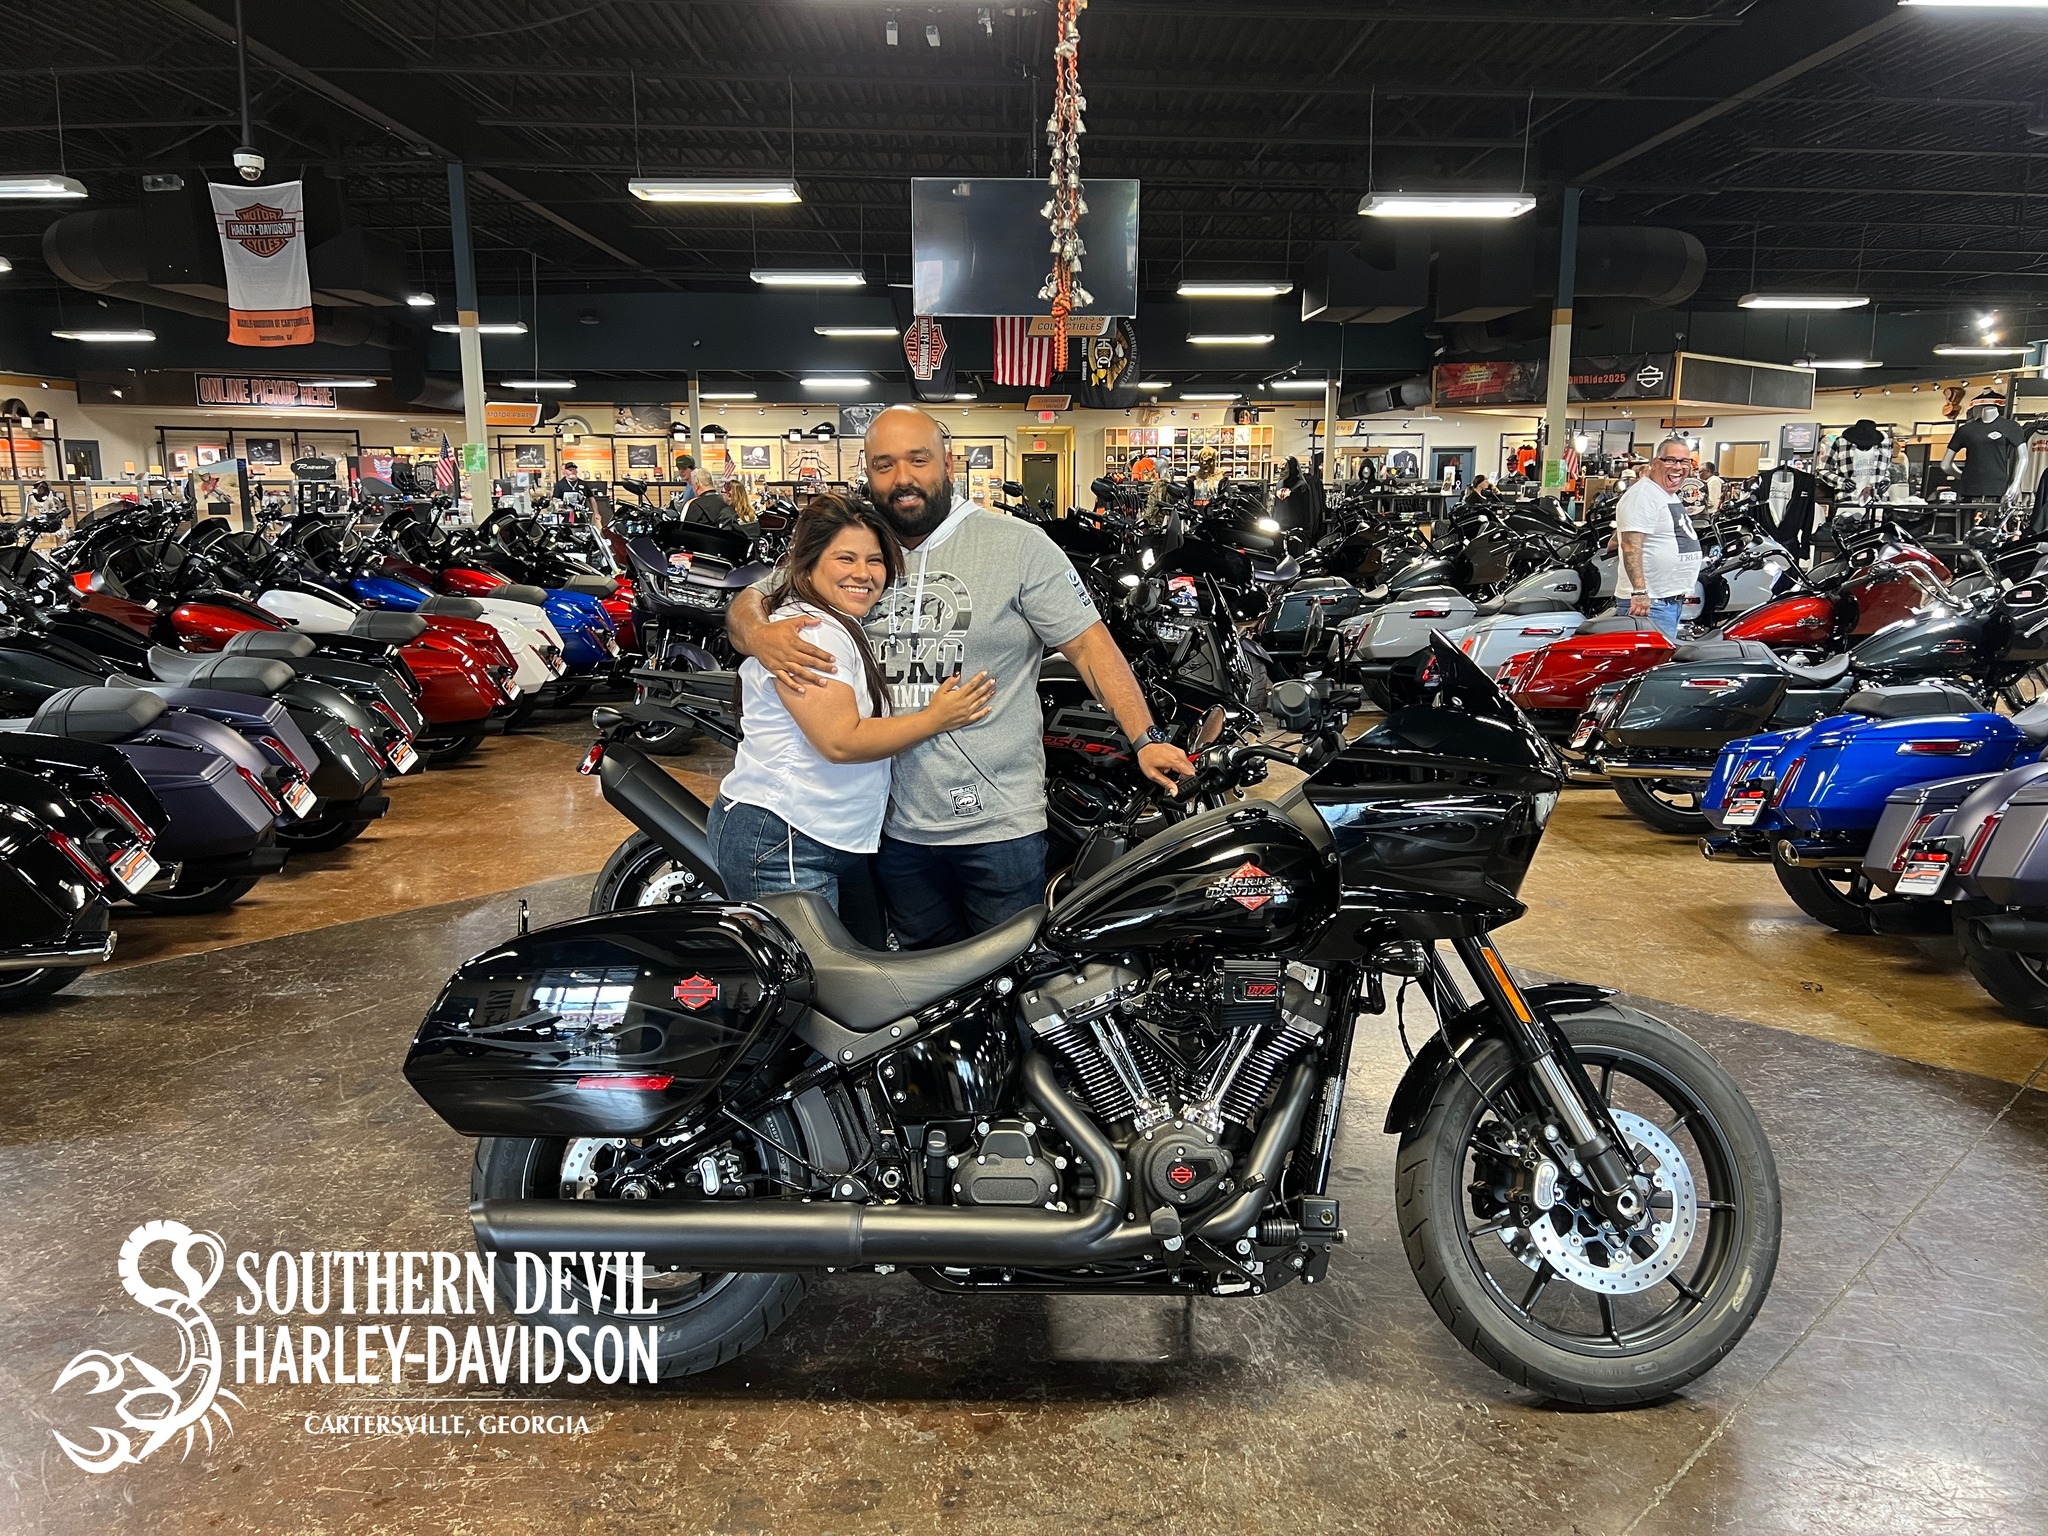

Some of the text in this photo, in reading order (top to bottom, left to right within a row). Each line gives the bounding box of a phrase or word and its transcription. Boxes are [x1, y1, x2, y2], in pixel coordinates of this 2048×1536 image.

[242, 209, 278, 221] MOTOR
[230, 222, 293, 236] HARLEY-DAVIDSON
[247, 239, 281, 253] CYCLES
[1037, 323, 1102, 331] COLCTIBLES
[1123, 320, 1138, 360] CARTERSVILLE
[907, 331, 918, 362] CYCLES
[919, 318, 930, 375] HARLEY-DAVIDSON
[932, 331, 940, 362] MOTOR
[200, 377, 334, 406] ONLINE PICKUP HERE
[1568, 374, 1626, 385] DHDRide2025
[870, 637, 965, 684] CKO
[892, 685, 939, 708] IMIT
